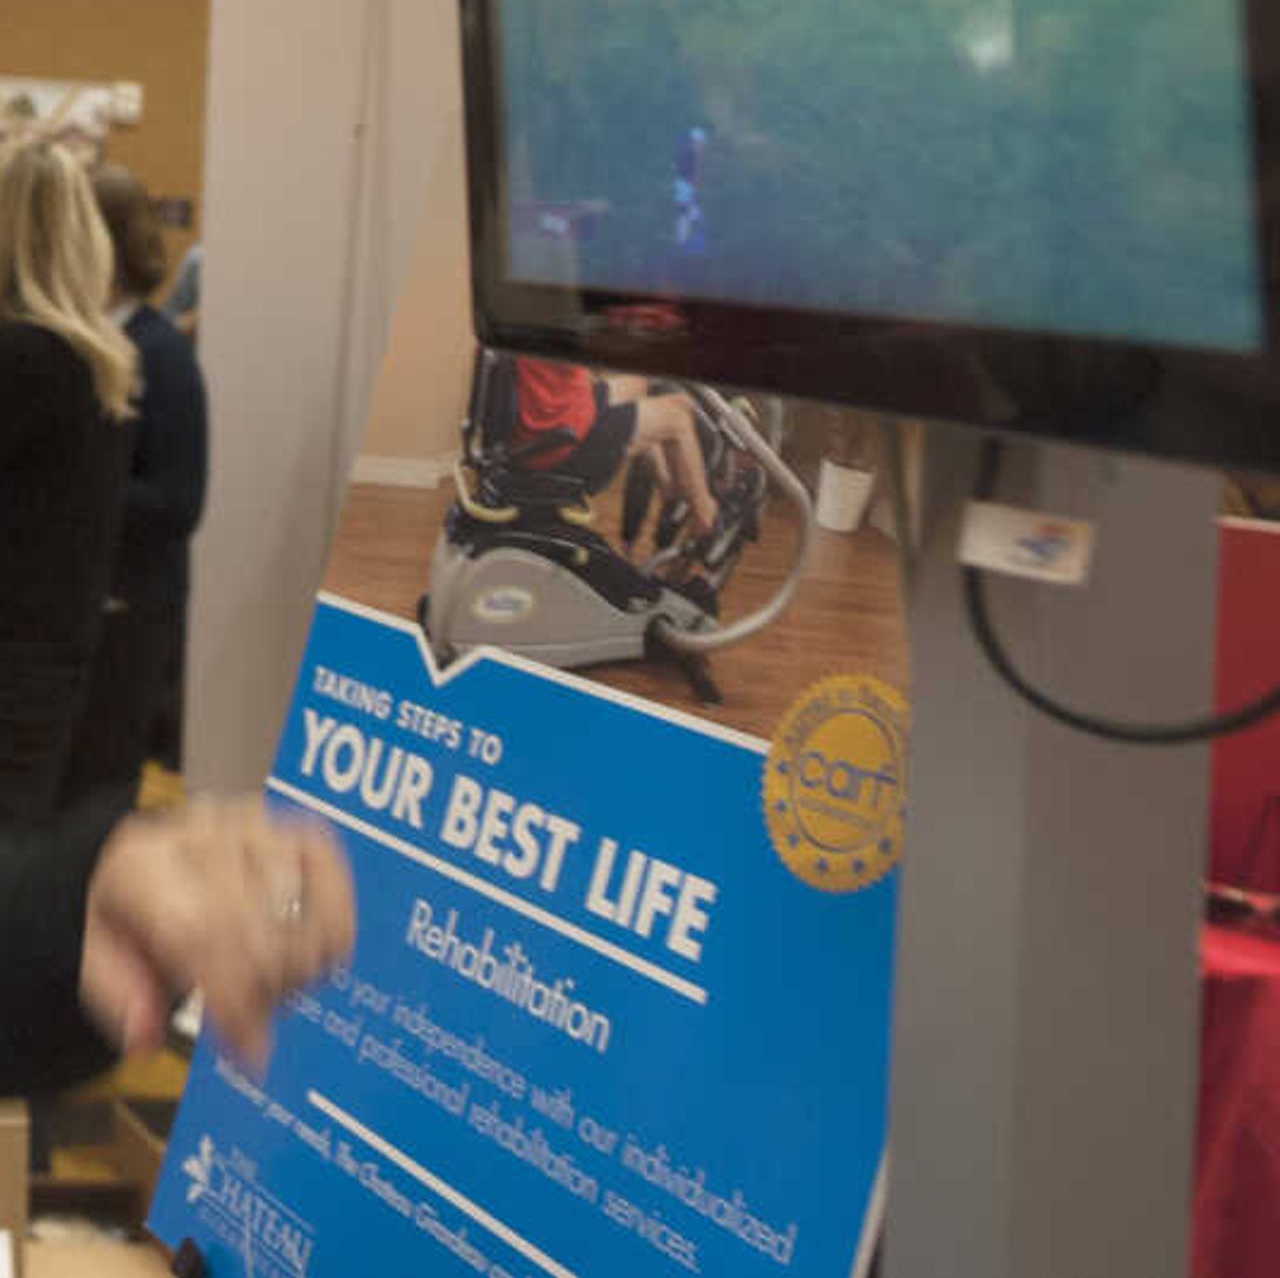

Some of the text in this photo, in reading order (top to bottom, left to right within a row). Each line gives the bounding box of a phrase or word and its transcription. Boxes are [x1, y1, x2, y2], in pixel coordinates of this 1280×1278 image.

[313, 664, 504, 766] TAKING STEPS TO
[298, 708, 720, 963] YOUR BEST LIFE
[406, 898, 612, 1054] Rehabilitation
[323, 1010, 364, 1047] and
[358, 1034, 470, 1116] professional
[469, 1101, 599, 1203] rehabilitation
[349, 980, 391, 1013] your
[392, 996, 527, 1100] independence
[530, 1085, 576, 1129] with
[577, 1117, 619, 1155] our
[621, 1131, 798, 1265] individualized
